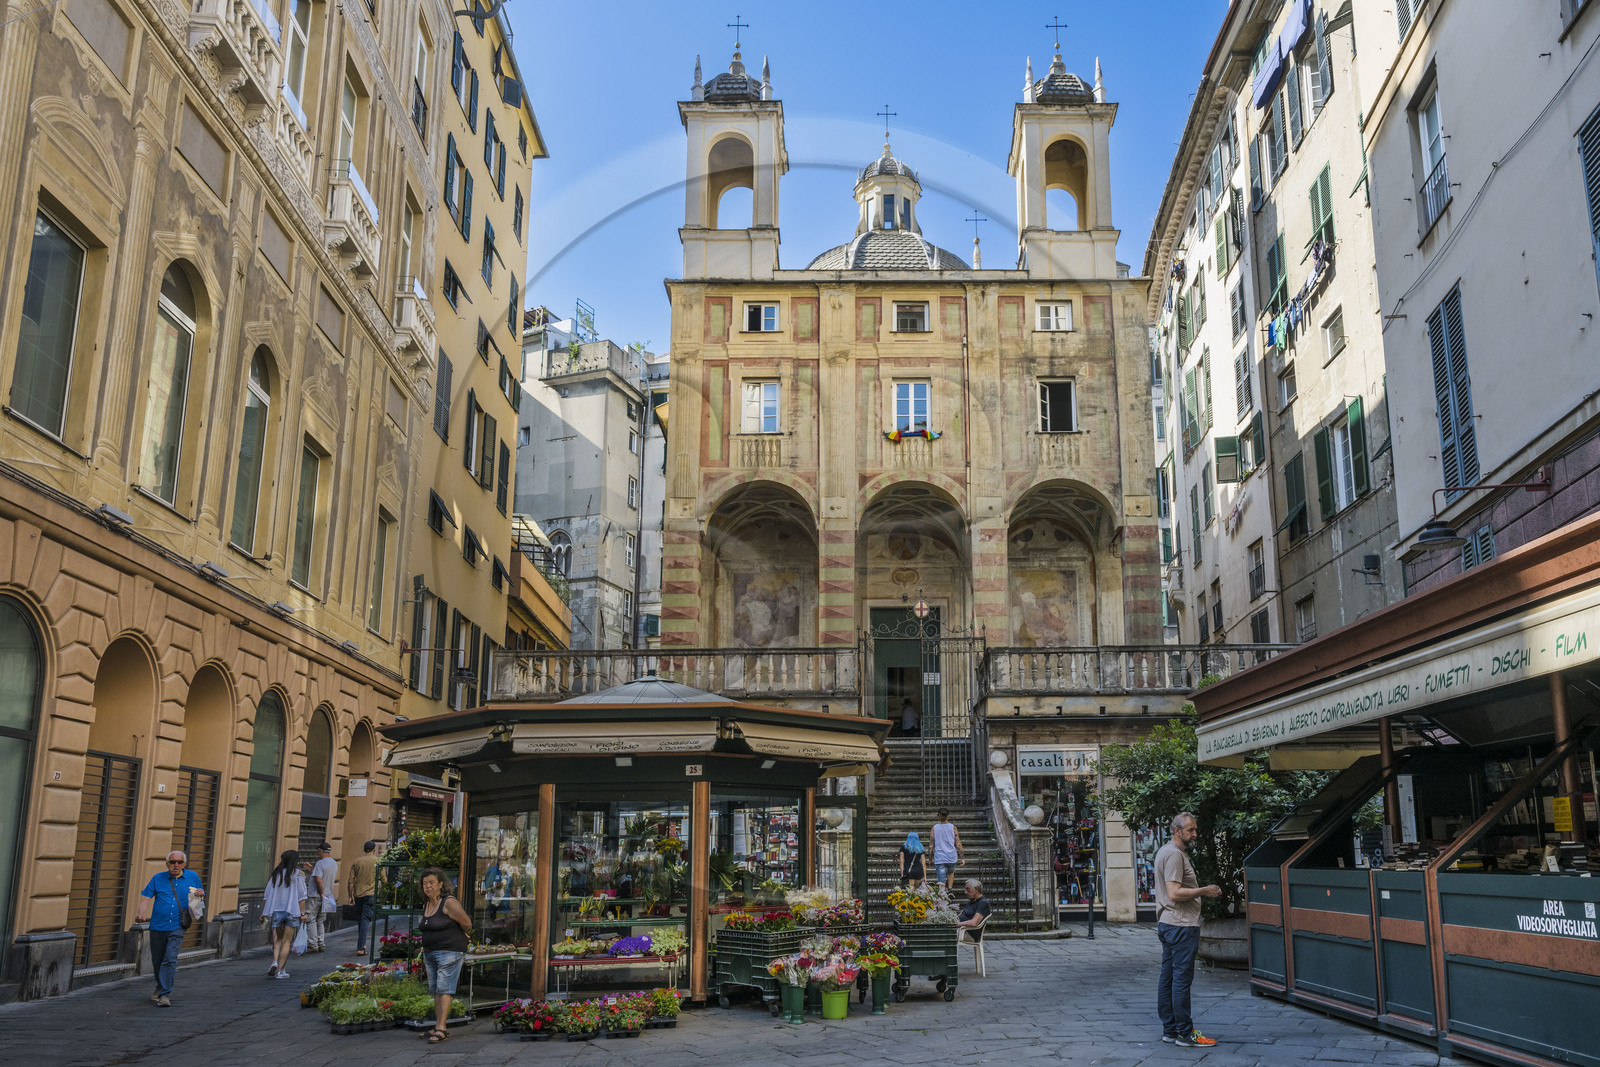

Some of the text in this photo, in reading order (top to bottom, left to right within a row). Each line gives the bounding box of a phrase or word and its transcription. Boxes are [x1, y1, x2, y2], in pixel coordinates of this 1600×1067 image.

[1205, 741, 1212, 754] LA
[1213, 733, 1243, 753] BANCARELLA
[1244, 731, 1250, 744] DI
[1252, 724, 1279, 742] SEVERINO
[1280, 721, 1285, 735] &
[1289, 711, 1318, 733] ALBERTO
[1320, 691, 1384, 723] COMPRAVENDITA
[1387, 685, 1410, 705] LIBRI
[1424, 665, 1471, 694] FUMETTI
[1491, 648, 1531, 676] DISCHI
[1556, 632, 1587, 657] FILM
[689, 766, 698, 774] 25
[1543, 900, 1565, 916] AREA
[1517, 915, 1598, 938] VIDEOSORVEGLIATA
